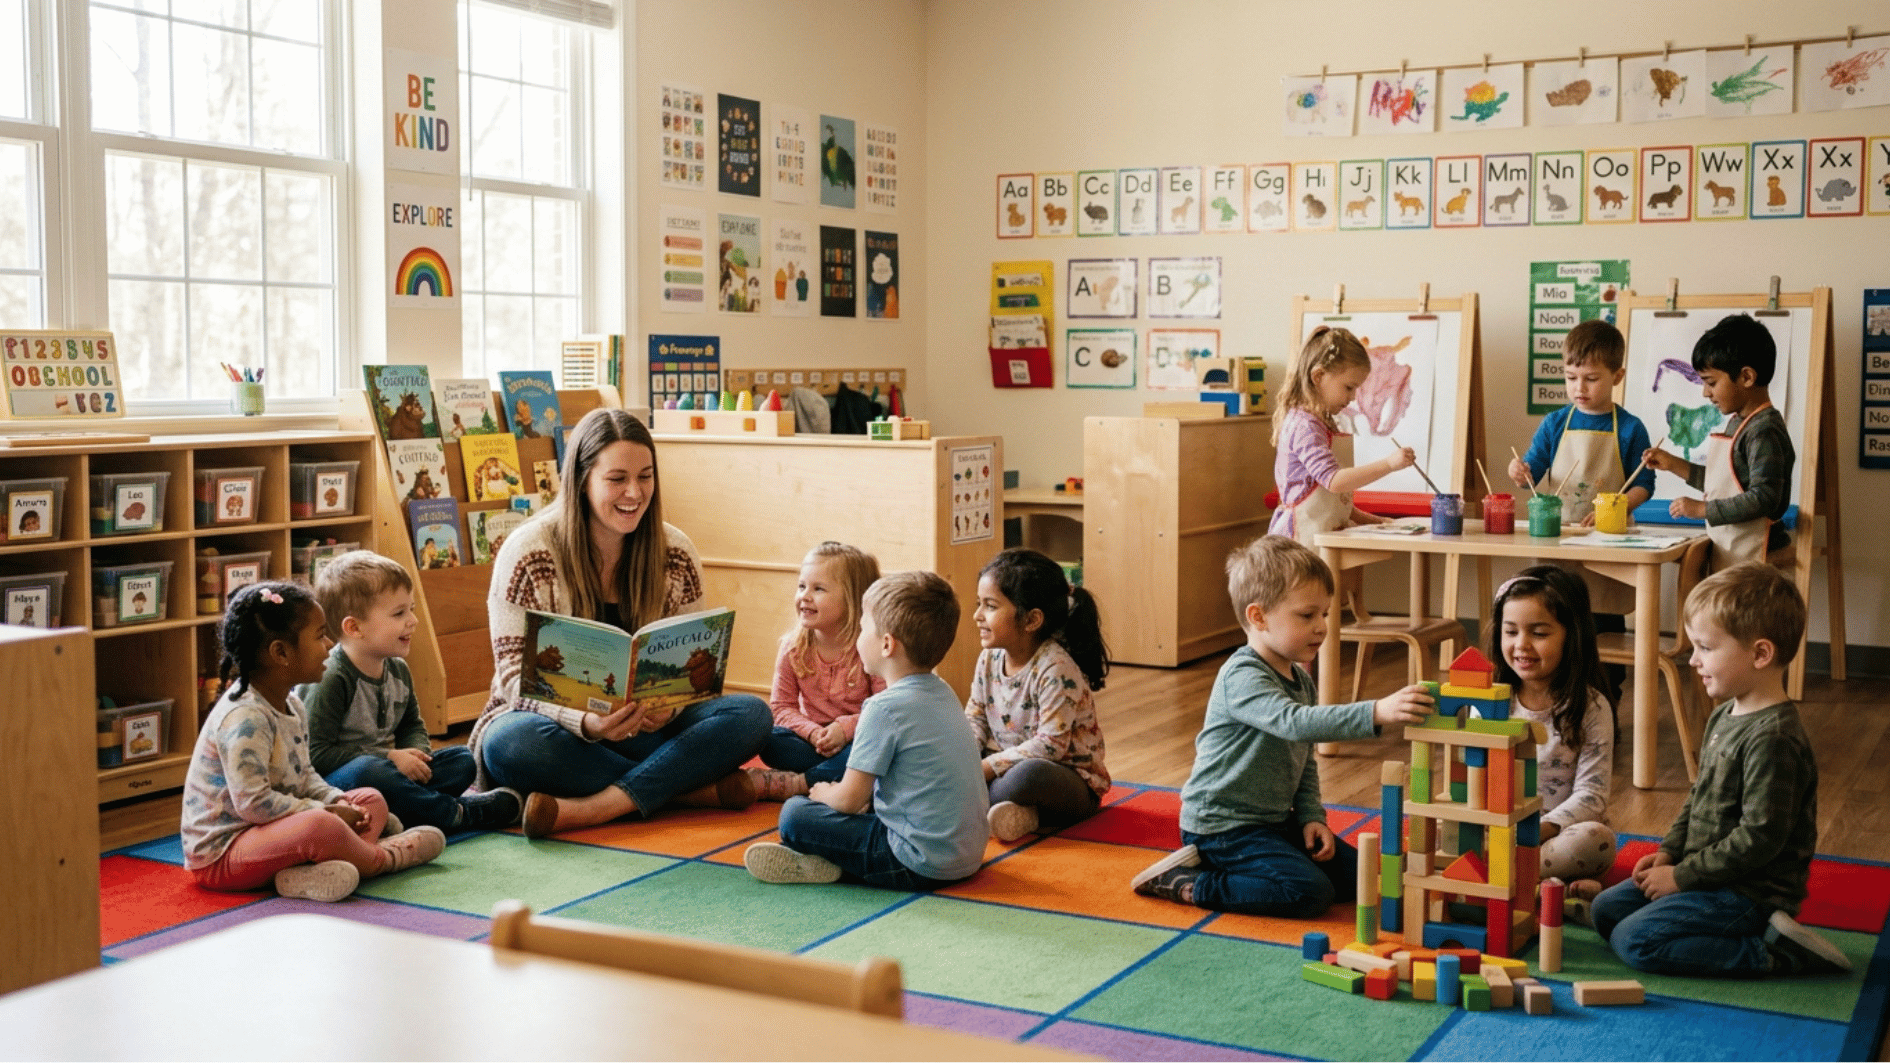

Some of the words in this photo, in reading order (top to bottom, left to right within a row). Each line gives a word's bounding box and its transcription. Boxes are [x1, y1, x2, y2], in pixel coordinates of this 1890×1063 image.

[407, 73, 436, 112] BE
[394, 112, 450, 152] KIND
[1593, 156, 1629, 178] Oo
[1701, 151, 1743, 173] Ww
[1762, 148, 1794, 171] Xx
[1819, 145, 1853, 168] Xx
[1394, 165, 1422, 186] Kk
[1448, 163, 1468, 184] Ll
[1488, 161, 1528, 182] Mm
[1542, 158, 1574, 180] Nn
[1650, 154, 1681, 181] Pp
[1003, 181, 1028, 198] Aa
[1044, 178, 1068, 197] Bb
[1084, 176, 1109, 195] Cc
[1125, 174, 1151, 194] Dd
[1170, 173, 1193, 192] Ee
[1214, 170, 1236, 190] Ff
[1254, 170, 1285, 194] Gg
[1349, 166, 1372, 193] Jj
[393, 203, 453, 228] EXPLORE
[1075, 276, 1092, 296] A
[1156, 275, 1172, 295] B
[1542, 287, 1567, 299] Mia
[1074, 346, 1091, 367] C
